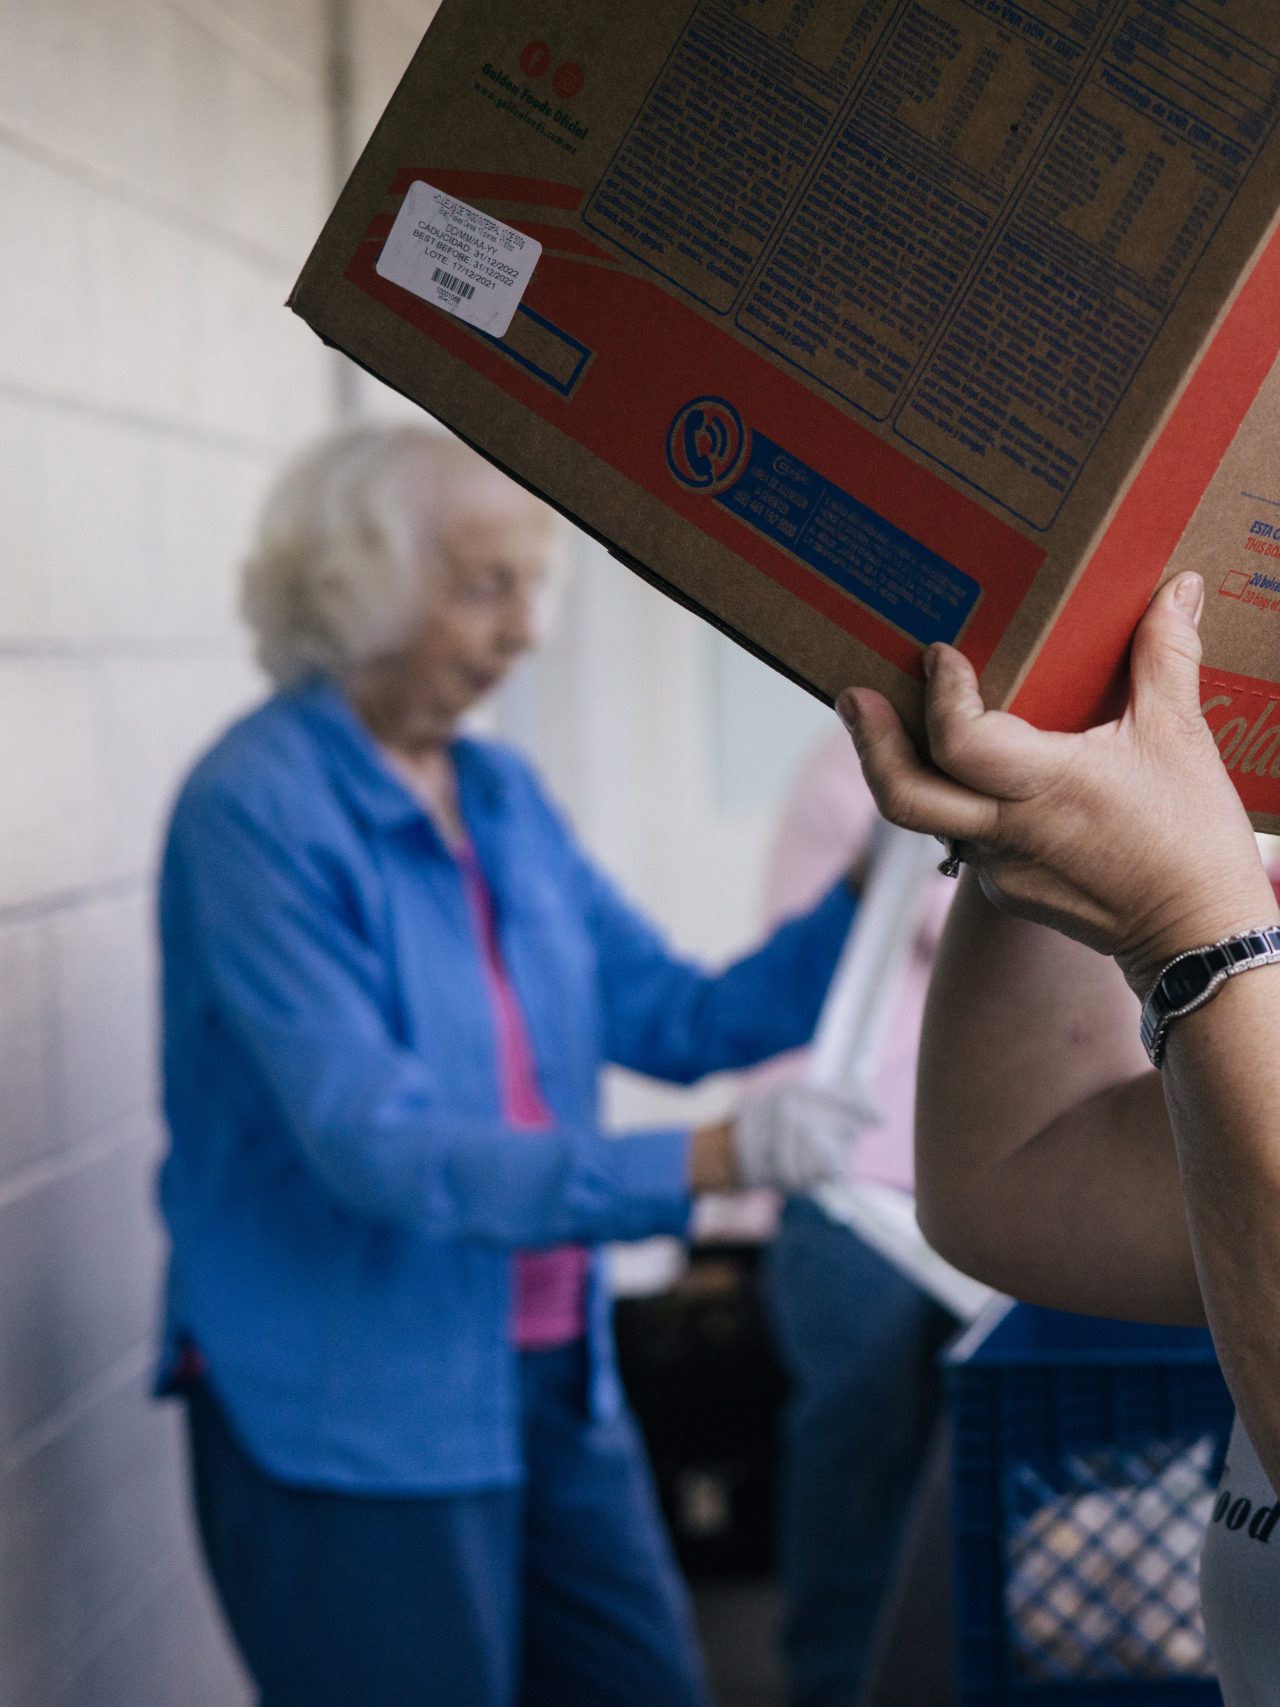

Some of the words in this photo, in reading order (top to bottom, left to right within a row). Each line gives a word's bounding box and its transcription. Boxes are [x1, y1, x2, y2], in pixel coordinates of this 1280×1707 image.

[480, 60, 522, 95] Golden
[519, 87, 553, 116] Foods
[551, 108, 589, 140] Oficial
[1099, 67, 1153, 109] Porcentaje
[445, 223, 498, 257] DD/MM/AA-YY
[411, 228, 435, 246] BEST
[472, 260, 514, 288] 31/12/2022
[472, 248, 519, 279] 31/12/2022
[451, 260, 497, 290] 17/12/2021
[1248, 519, 1276, 538] ESTA
[1242, 536, 1268, 554] THIS
[1248, 571, 1263, 586] 20
[1241, 589, 1255, 603] 20
[1249, 591, 1274, 612] bags
